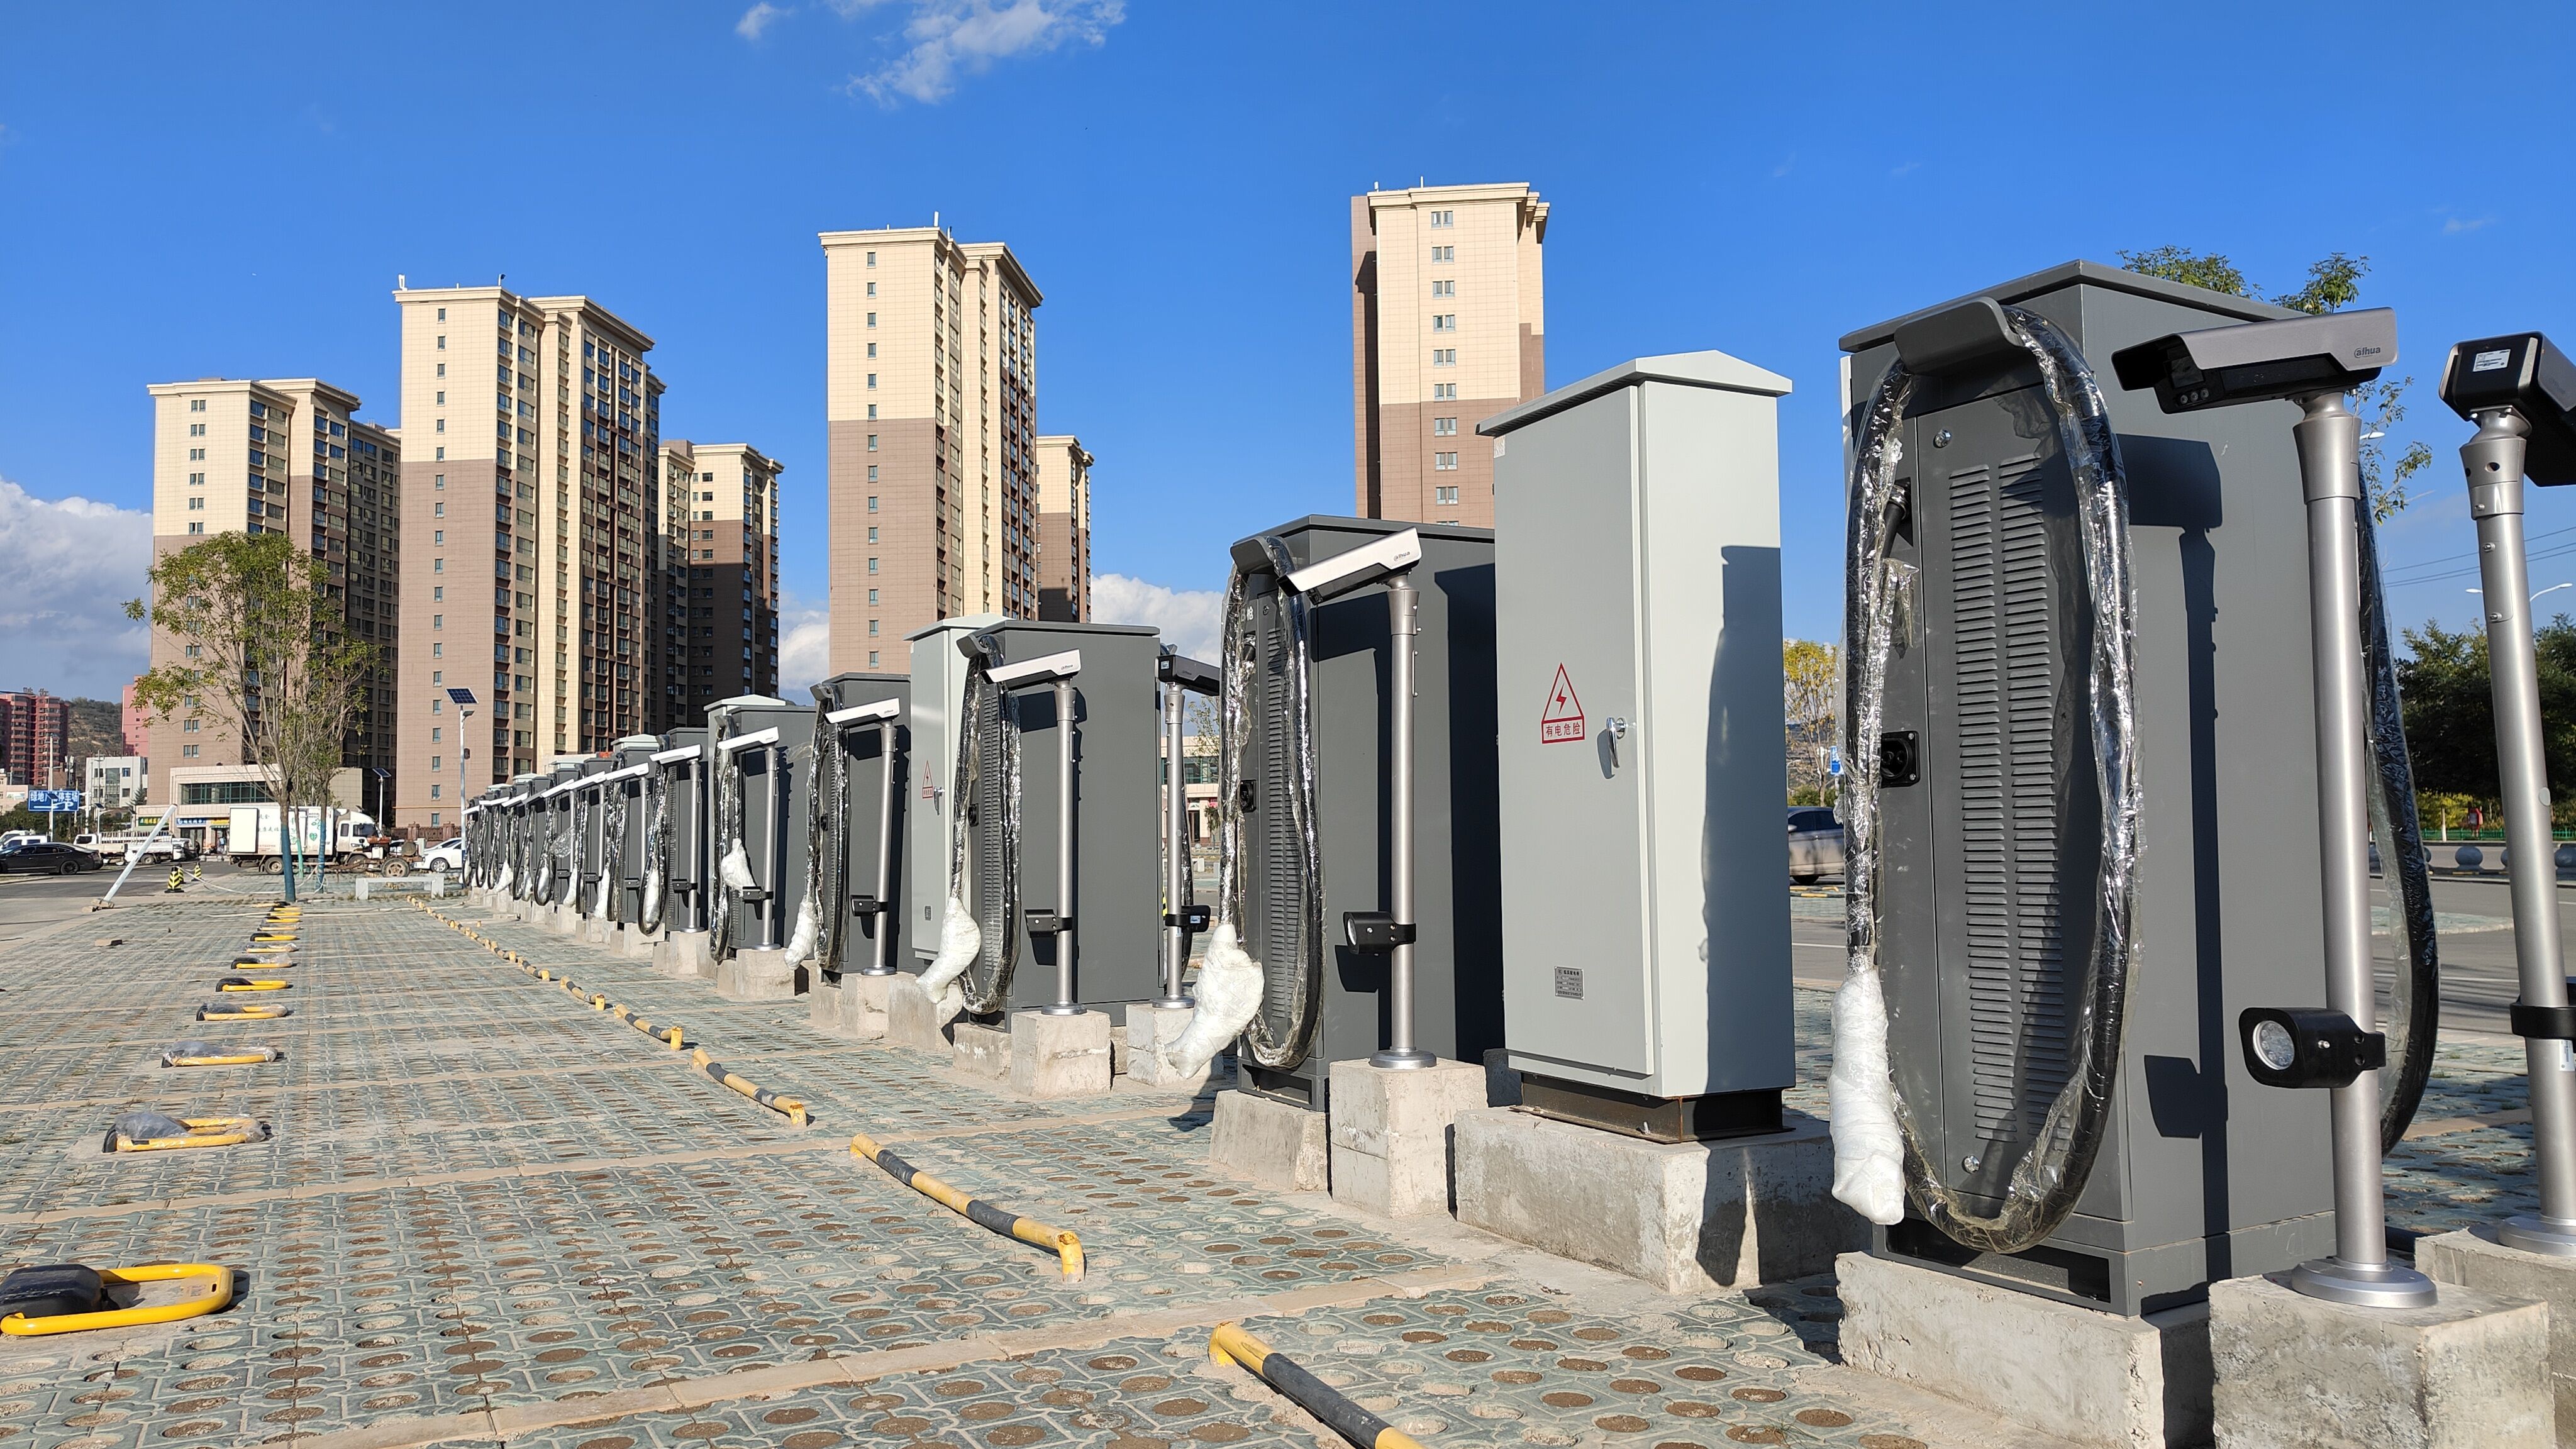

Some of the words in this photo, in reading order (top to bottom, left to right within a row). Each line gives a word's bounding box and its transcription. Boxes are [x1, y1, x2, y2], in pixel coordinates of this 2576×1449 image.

[1546, 722, 1580, 737] 有电危险
[30, 791, 78, 802] 绿地广停车场
